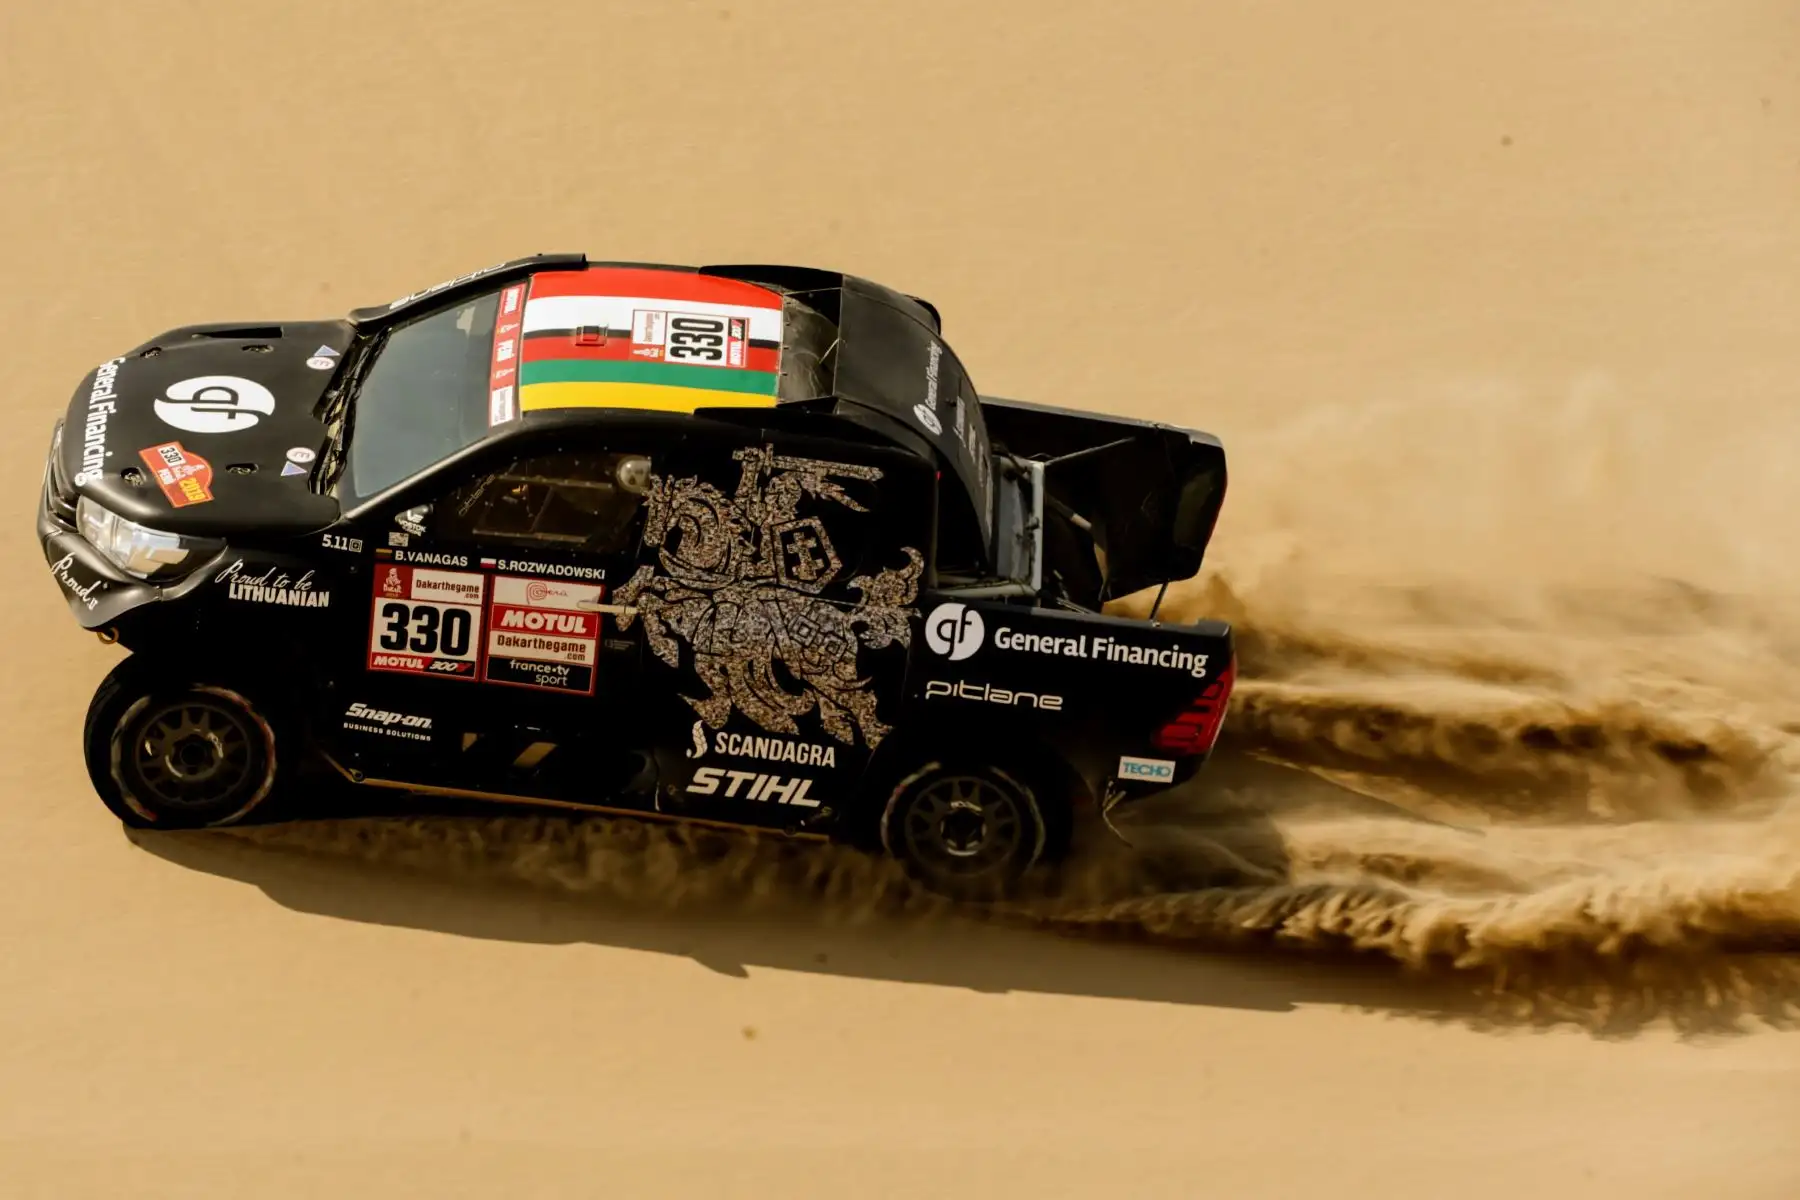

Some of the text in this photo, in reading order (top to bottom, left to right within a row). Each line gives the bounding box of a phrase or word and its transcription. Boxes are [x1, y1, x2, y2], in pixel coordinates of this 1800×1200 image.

[669, 317, 724, 361] 330
[74, 357, 126, 487] General Financing
[160, 447, 182, 463] 330
[322, 533, 348, 551] 5.11
[395, 550, 468, 567] B.VANAGAS
[497, 559, 606, 580] S.ROZWADOWSKI
[214, 558, 316, 591] Proud to be
[415, 579, 480, 593] Dakarthegame
[228, 583, 330, 608] LITHUANIAN
[380, 602, 472, 657] 330
[500, 609, 588, 634] MOTUL
[497, 634, 587, 653] Dakarthegame
[994, 627, 1209, 678] General Financing
[373, 655, 425, 669] MOTUL
[535, 674, 568, 687] sport
[925, 679, 1064, 711] pitlane
[343, 722, 432, 742] BUSINESS SOLUTIONS
[714, 731, 836, 769] SCANDAGRA
[686, 766, 822, 808] STIHL
